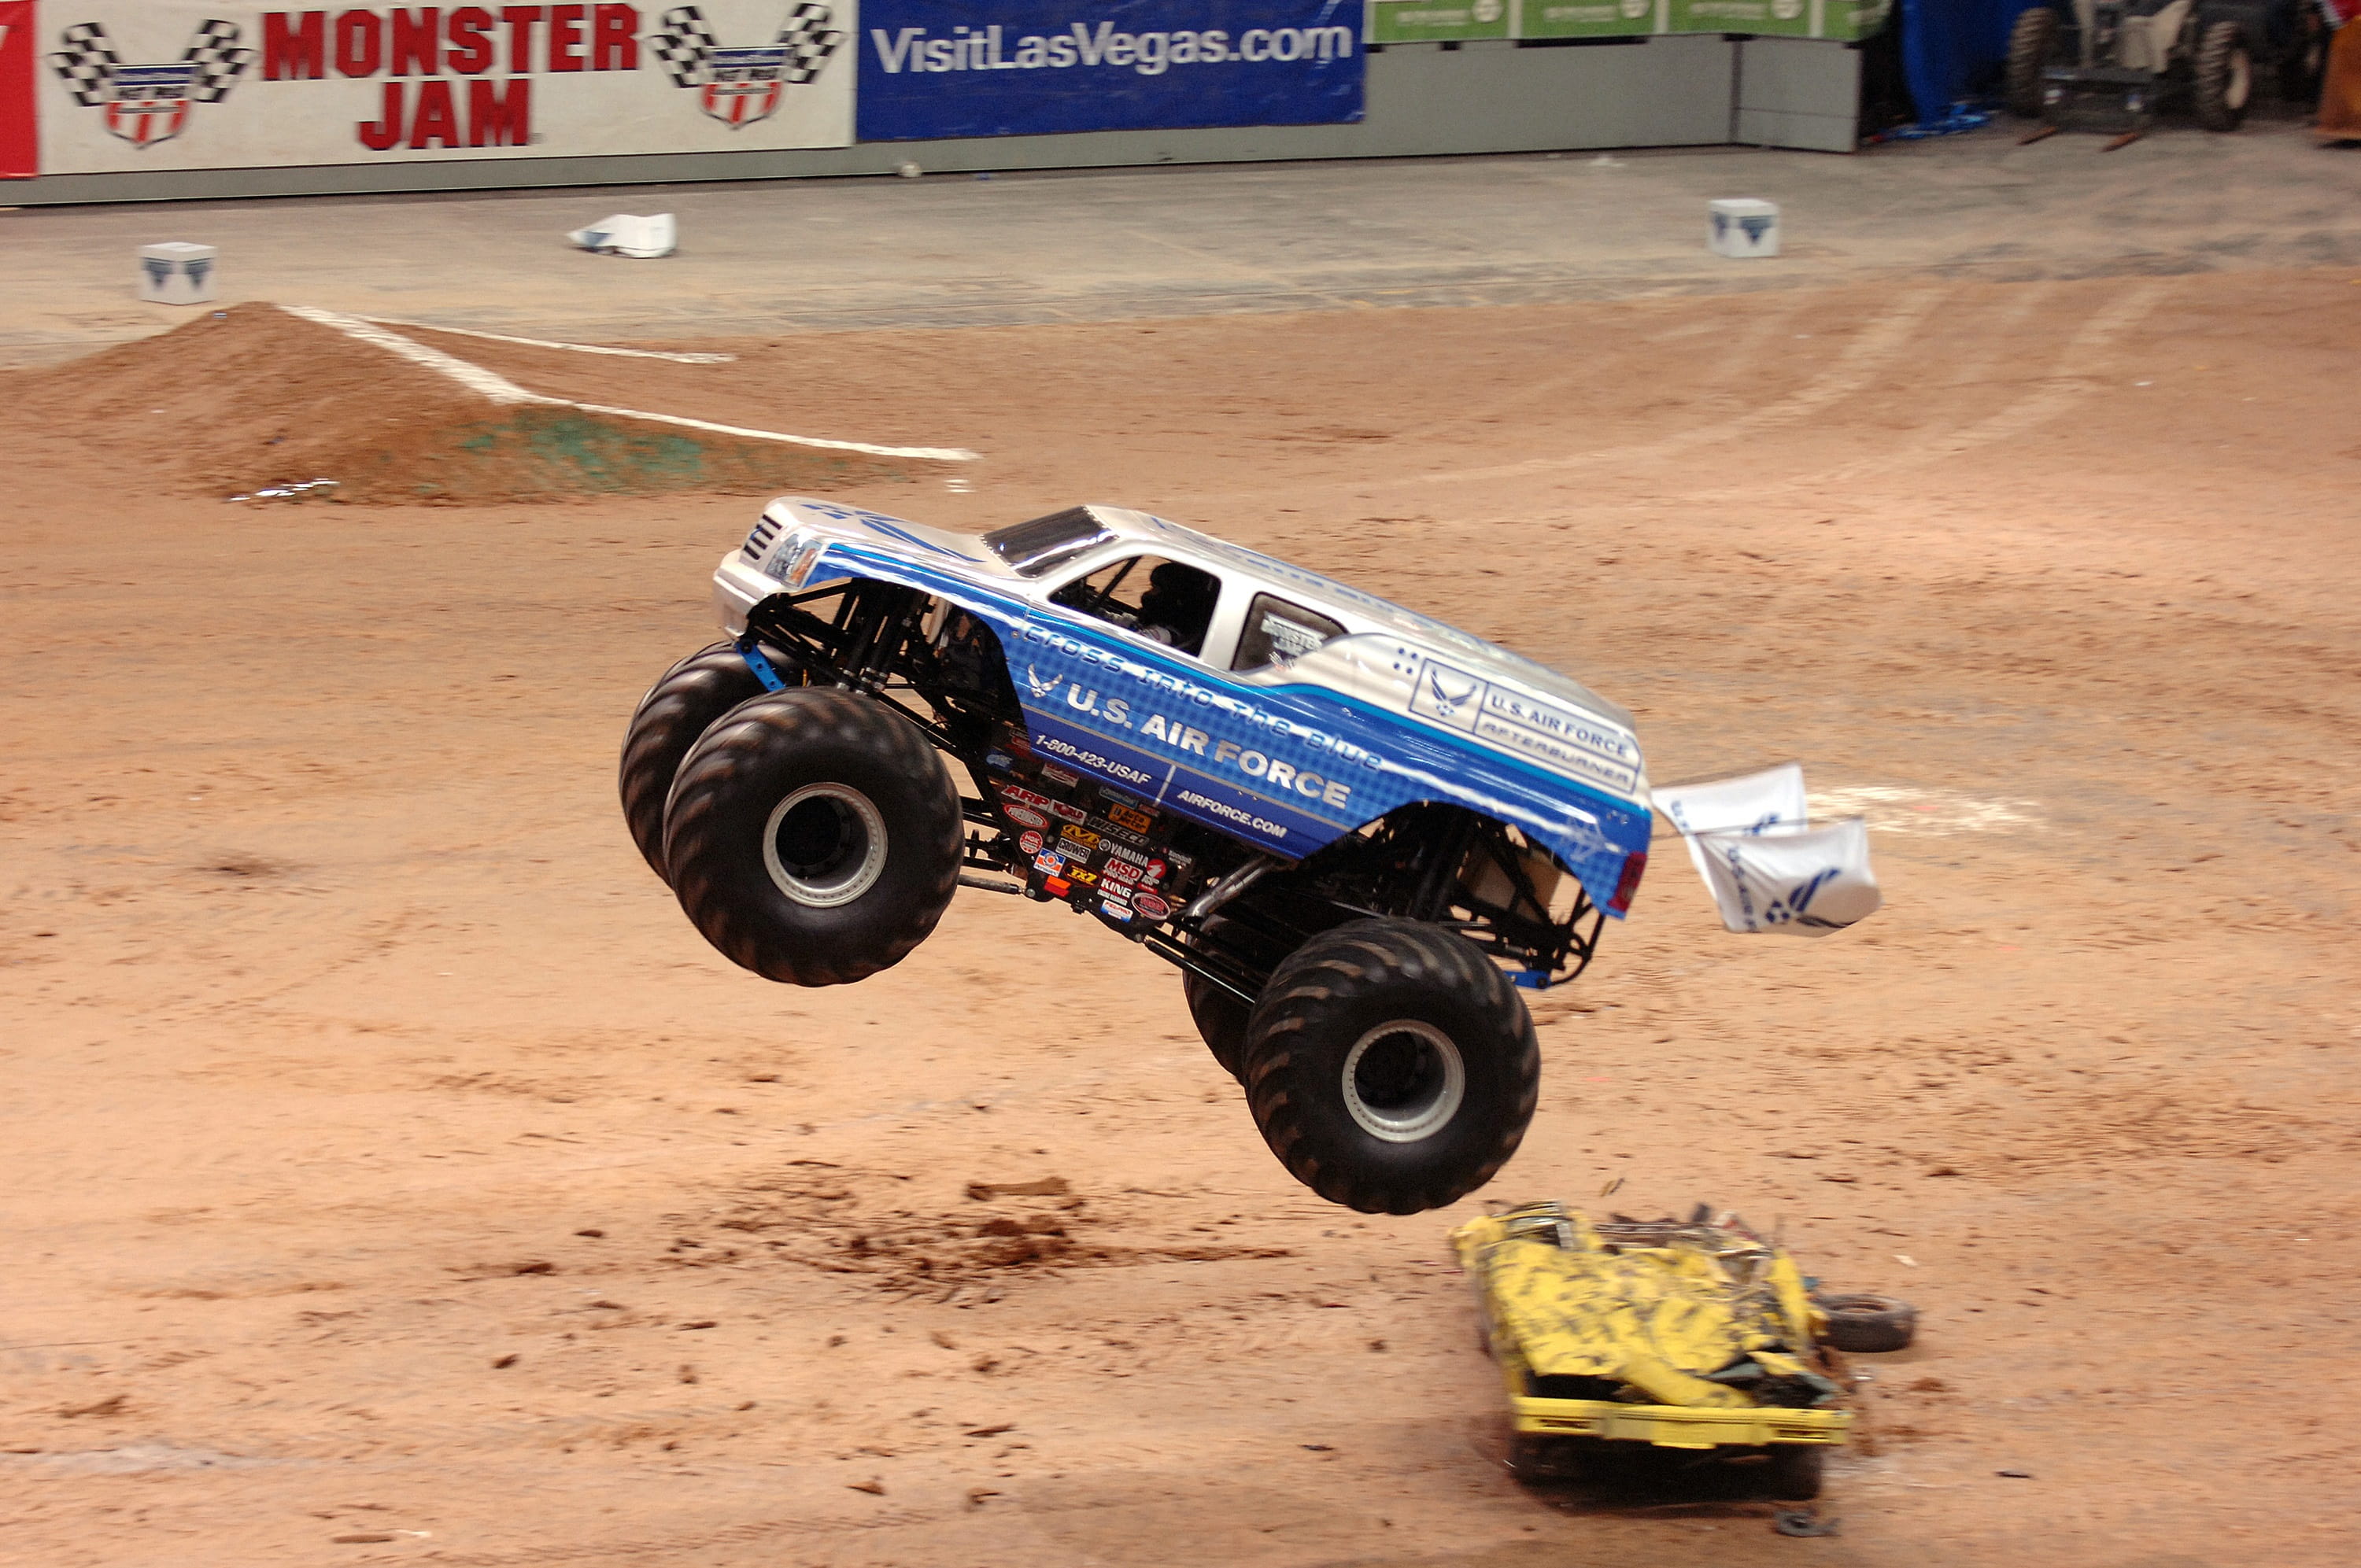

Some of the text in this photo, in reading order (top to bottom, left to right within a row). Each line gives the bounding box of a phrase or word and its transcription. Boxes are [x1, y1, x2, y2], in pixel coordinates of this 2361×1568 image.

[263, 3, 639, 80] MONSTER
[870, 20, 1354, 76] VisitLasVegas.com
[357, 79, 530, 150] JAM
[1066, 683, 1352, 810] U.S. AIR FORCE
[1491, 695, 1628, 757] U.S. AIR FORCE
[1036, 734, 1152, 785] 1-800-423-USAF
[1482, 721, 1630, 784] AFTERBURNER
[1004, 785, 1050, 806] ARP
[1177, 789, 1288, 839] AIRFORCE.COM
[1059, 839, 1089, 859] CROWER
[1107, 859, 1140, 879] MSD
[1110, 843, 1149, 868] YAMAHA
[1101, 878, 1132, 898] KING
